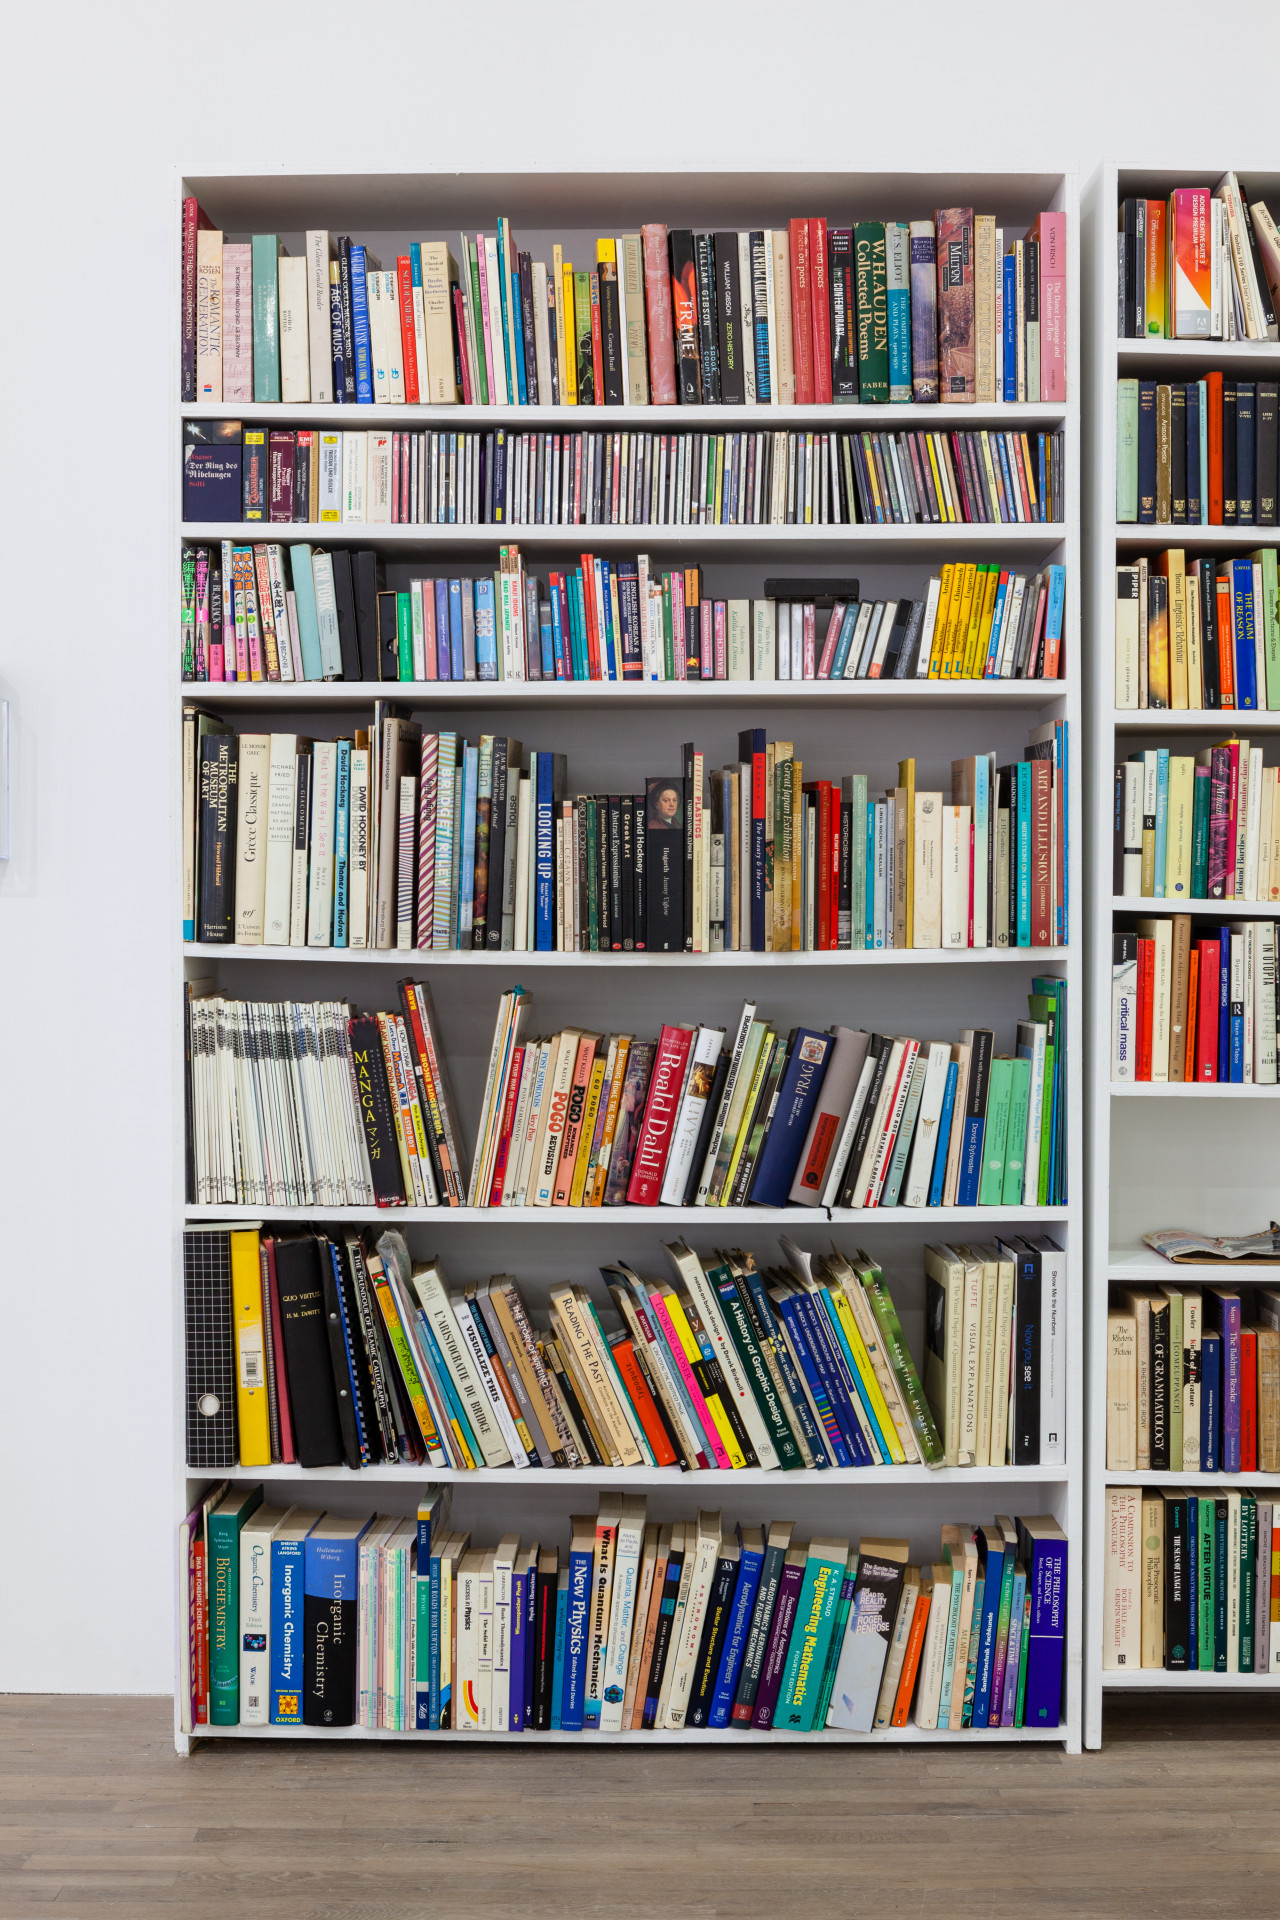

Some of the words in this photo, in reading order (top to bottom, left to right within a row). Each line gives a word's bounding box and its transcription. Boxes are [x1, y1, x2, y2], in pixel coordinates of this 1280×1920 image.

[857, 240, 870, 311] Collected
[331, 288, 341, 310] ABC
[403, 270, 412, 328] SCHOENBERG
[199, 277, 208, 356] GENERATION
[210, 289, 220, 356] ROMANTIC
[332, 312, 341, 326] OF
[1047, 317, 1053, 326] of
[333, 328, 343, 361] MUSIC
[860, 313, 870, 360] Poems
[942, 568, 952, 596] Arabisch
[953, 568, 964, 602] Chinesisch
[964, 567, 975, 599] Ungarisch
[1236, 592, 1244, 604] OF
[630, 582, 638, 645] ENGLISH-KOREAN
[1173, 599, 1183, 628] Linguistic
[1175, 632, 1184, 664] Behaviour
[201, 761, 209, 777] OF
[210, 761, 218, 808] MUSEUM
[480, 752, 491, 787] Titian
[1038, 767, 1048, 792] ART
[1158, 756, 1168, 785] Prisms
[218, 746, 227, 832] METROPOLITAN
[338, 775, 348, 807] Hockney
[439, 768, 451, 836] BRIDGET
[636, 810, 644, 834] David
[1038, 793, 1048, 820] AND
[538, 803, 551, 857] LOOKING
[358, 860, 366, 871] BY
[438, 842, 450, 887] RILEY
[611, 840, 620, 888] Expressionism
[635, 837, 644, 873] Hockney
[1037, 822, 1048, 882] ILLUSION
[537, 863, 551, 878] UP
[1263, 944, 1273, 952] IN
[1263, 956, 1274, 986] UTOPIA
[1120, 998, 1129, 1030] critical
[653, 1052, 680, 1111] Roald
[548, 1091, 567, 1132] POGO
[639, 1116, 669, 1167] Dahl
[970, 1123, 978, 1143] David
[544, 1135, 557, 1175] REVISITED
[967, 1145, 976, 1174] Sylvester
[353, 1254, 362, 1269] THE
[356, 1271, 370, 1314] SPLENDOUR
[731, 1302, 739, 1310] A
[1051, 1289, 1057, 1298] Me
[365, 1316, 371, 1327] OF
[734, 1310, 751, 1344] History
[1025, 1325, 1034, 1346] Now
[366, 1328, 377, 1357] ISLAMIC
[562, 1297, 585, 1339] READING
[580, 1341, 593, 1361] THE
[589, 1360, 604, 1384] PAST
[748, 1345, 757, 1355] of
[968, 1323, 977, 1355] VISUAL
[1023, 1348, 1032, 1364] you
[1155, 1344, 1164, 1358] OF
[466, 1325, 490, 1377] VISUALIZE
[484, 1377, 500, 1403] THIS
[751, 1356, 771, 1393] Graphic
[372, 1359, 386, 1408] CALLIGRAPHY
[893, 1343, 915, 1395] BEAUTIFUL
[912, 1399, 934, 1448] EVIDENCE
[966, 1360, 975, 1433] EXPLANATIONS
[461, 1385, 474, 1399] DU
[470, 1402, 491, 1435] BRIDGE
[766, 1395, 785, 1426] Design
[1155, 1360, 1164, 1449] GRAMMATOLOGY
[600, 1530, 612, 1561] What
[599, 1564, 608, 1574] Is
[1045, 1557, 1053, 1569] OF
[283, 1565, 294, 1618] Inorganic
[573, 1566, 588, 1598] New
[624, 1567, 634, 1599] Quanta,
[216, 1557, 230, 1650] BIOCHEMISTRY
[330, 1574, 346, 1644] Inorganic
[592, 1577, 606, 1631] Quantum
[620, 1601, 631, 1628] Matter,
[732, 1582, 752, 1634] Aerodynamics
[804, 1567, 831, 1633] Engineering
[1051, 1576, 1060, 1628] PHILOSOPHY
[568, 1601, 586, 1654] Physics
[731, 1635, 743, 1646] for
[281, 1622, 294, 1679] Chemistry
[313, 1621, 328, 1698] Chemistry
[616, 1644, 627, 1675] Change
[958, 1629, 968, 1665] MEMORY
[589, 1634, 604, 1699] Mechanics?
[722, 1648, 740, 1684] Engineers
[792, 1636, 816, 1706] Mathematics
